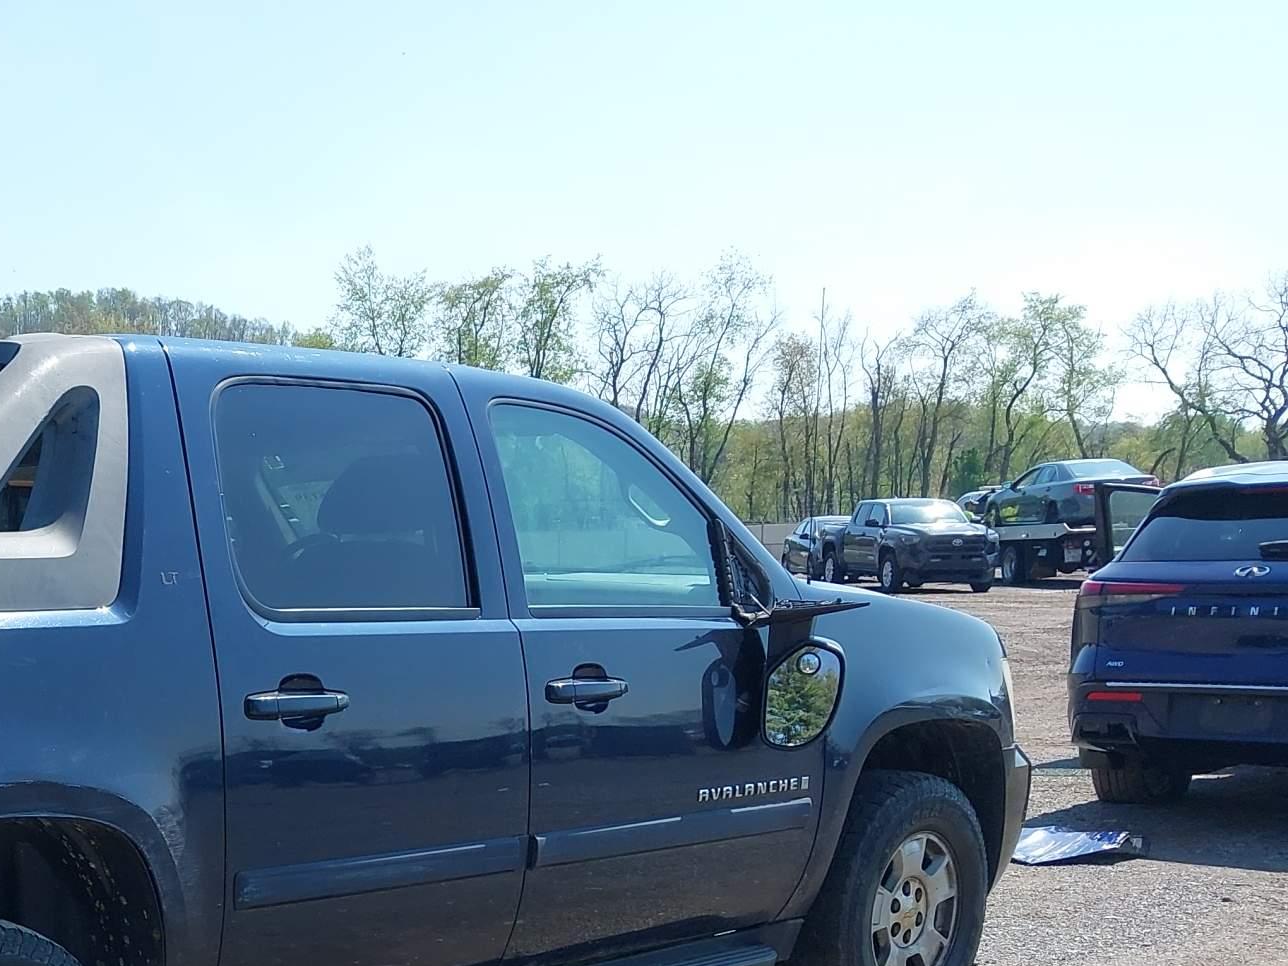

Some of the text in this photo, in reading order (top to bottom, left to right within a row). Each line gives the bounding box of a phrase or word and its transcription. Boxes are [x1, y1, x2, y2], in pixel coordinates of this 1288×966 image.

[160, 571, 179, 585] LT
[1105, 660, 1125, 668] AWD
[698, 778, 798, 802] AVALANCHE
